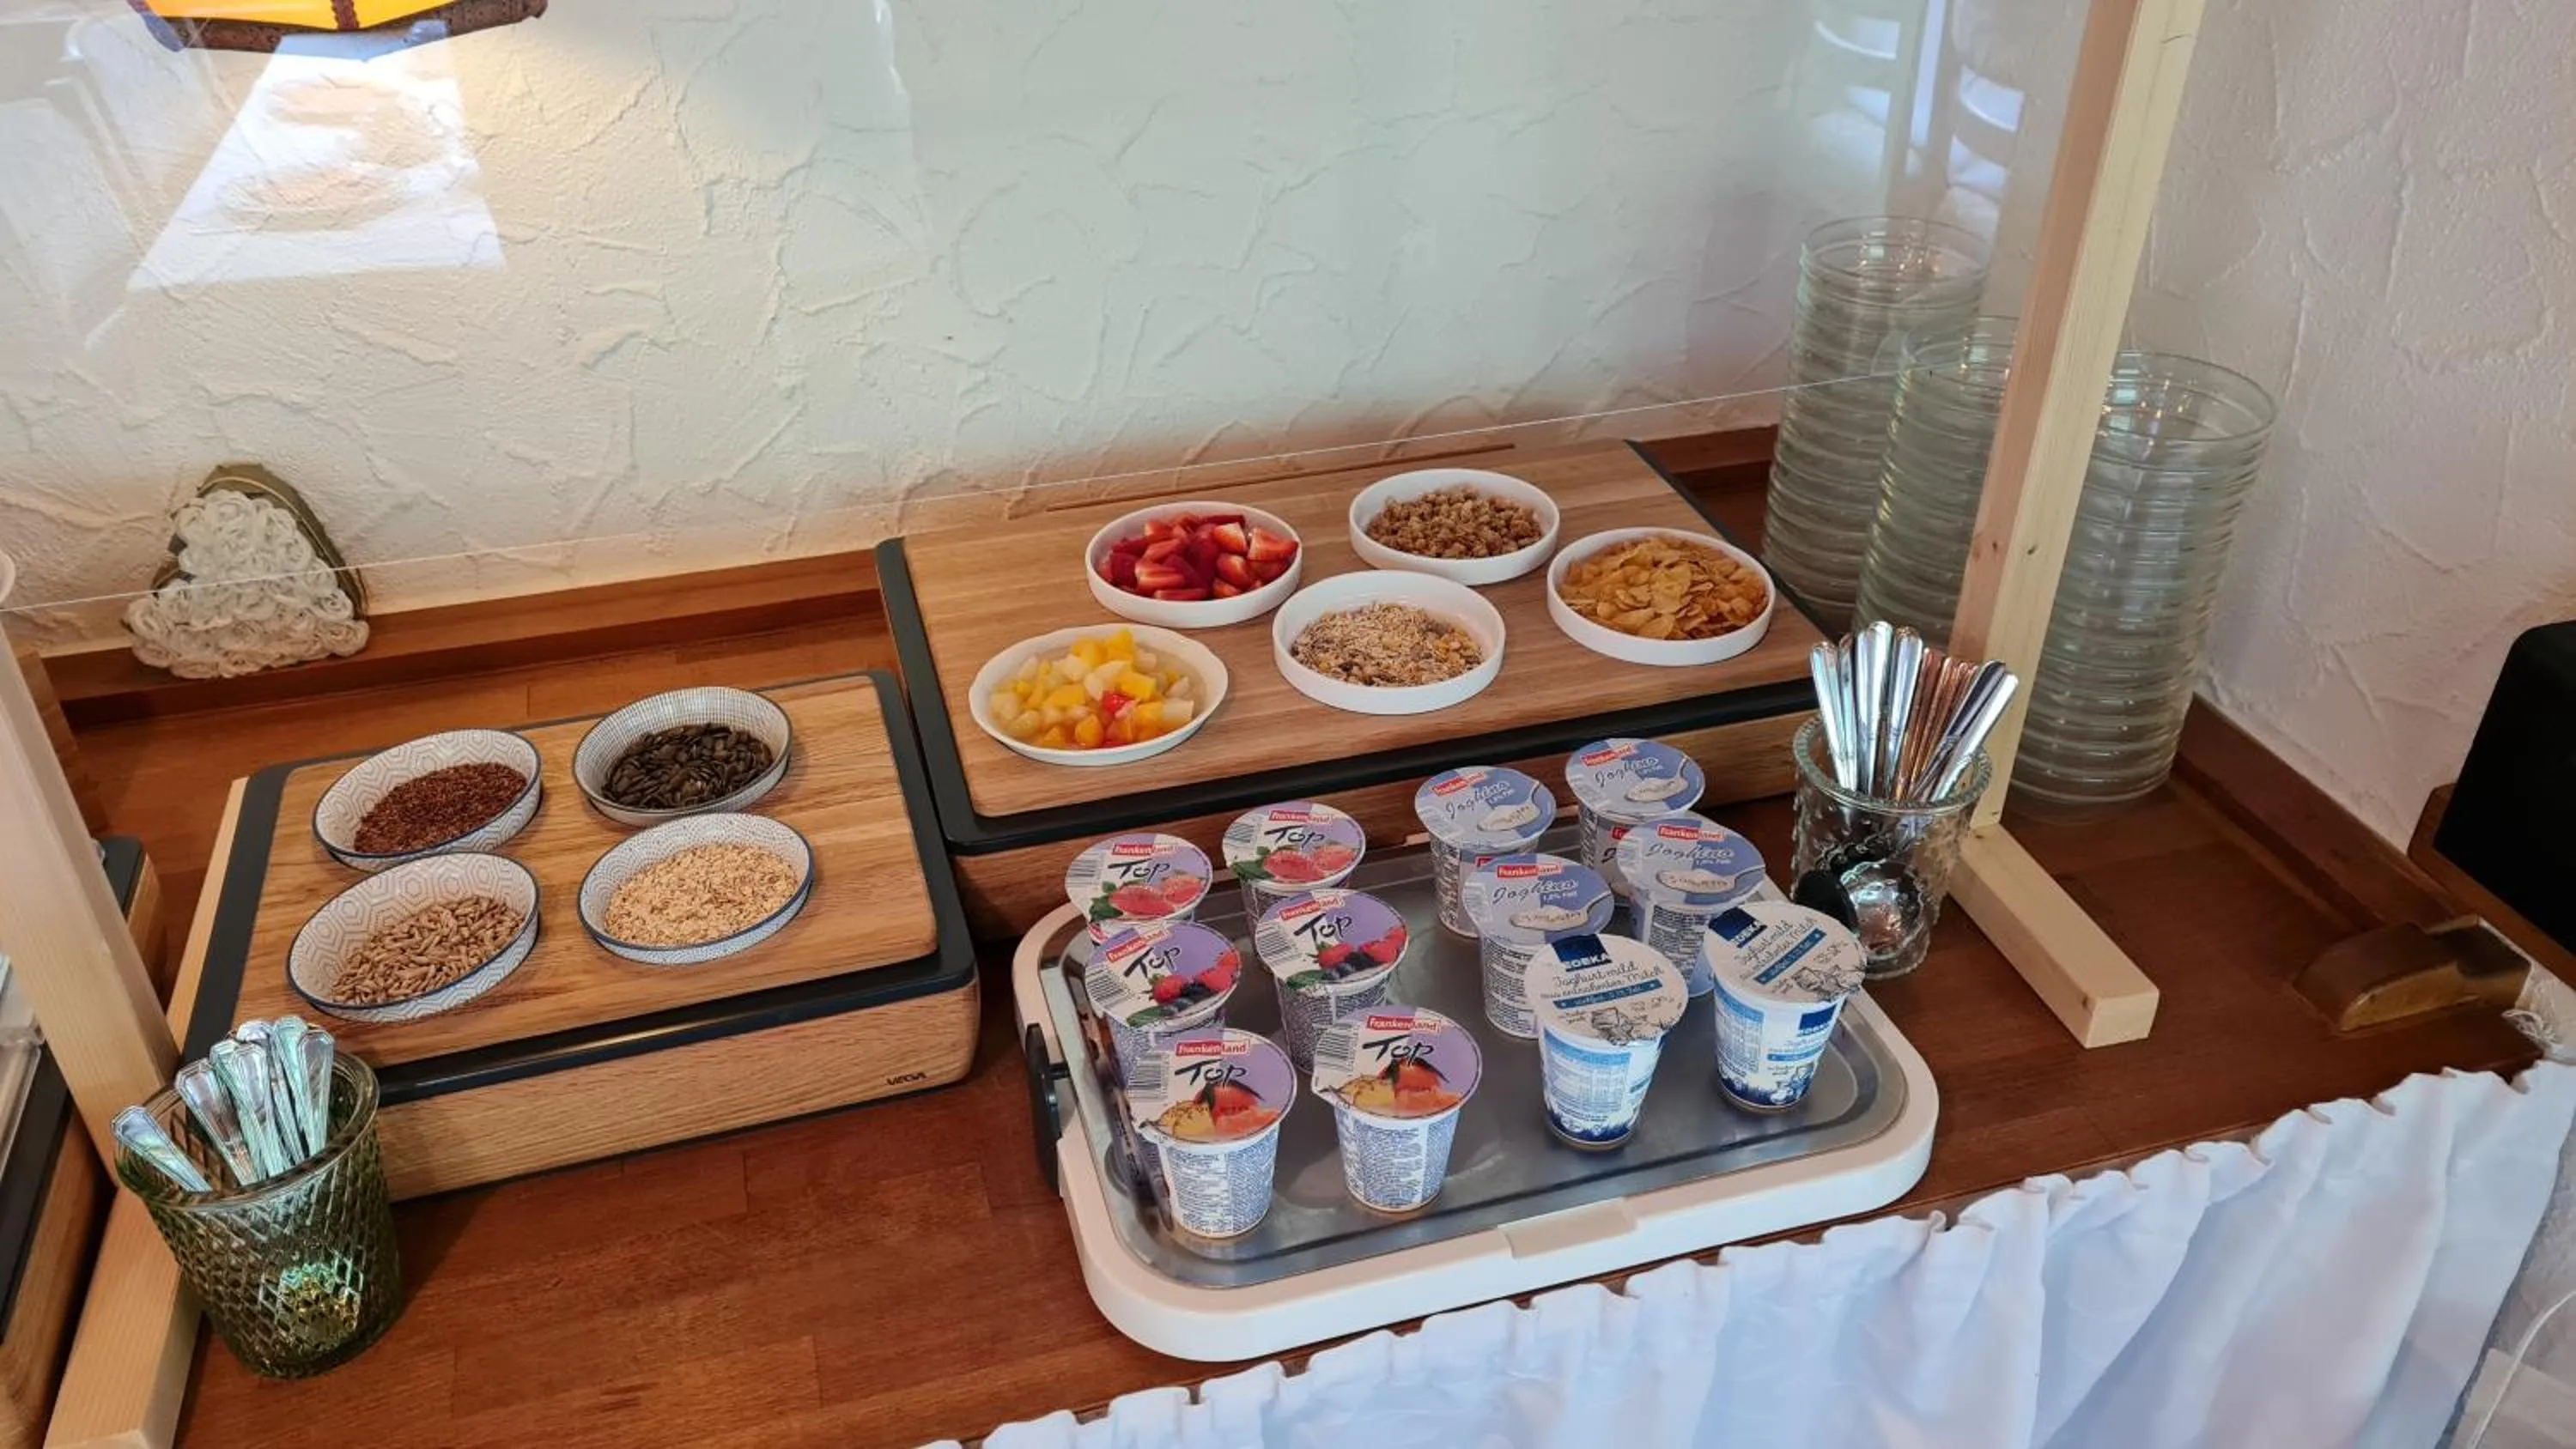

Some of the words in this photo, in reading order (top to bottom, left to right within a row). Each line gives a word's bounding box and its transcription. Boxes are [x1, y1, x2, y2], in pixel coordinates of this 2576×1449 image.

[1264, 825, 1325, 849] Top
[1108, 858, 1170, 882] Top
[1294, 912, 1352, 943] Top
[1123, 947, 1182, 978] Top
[1363, 1034, 1435, 1064] Top
[886, 1072, 927, 1086] VEGA
[1175, 1058, 1248, 1088] Top
